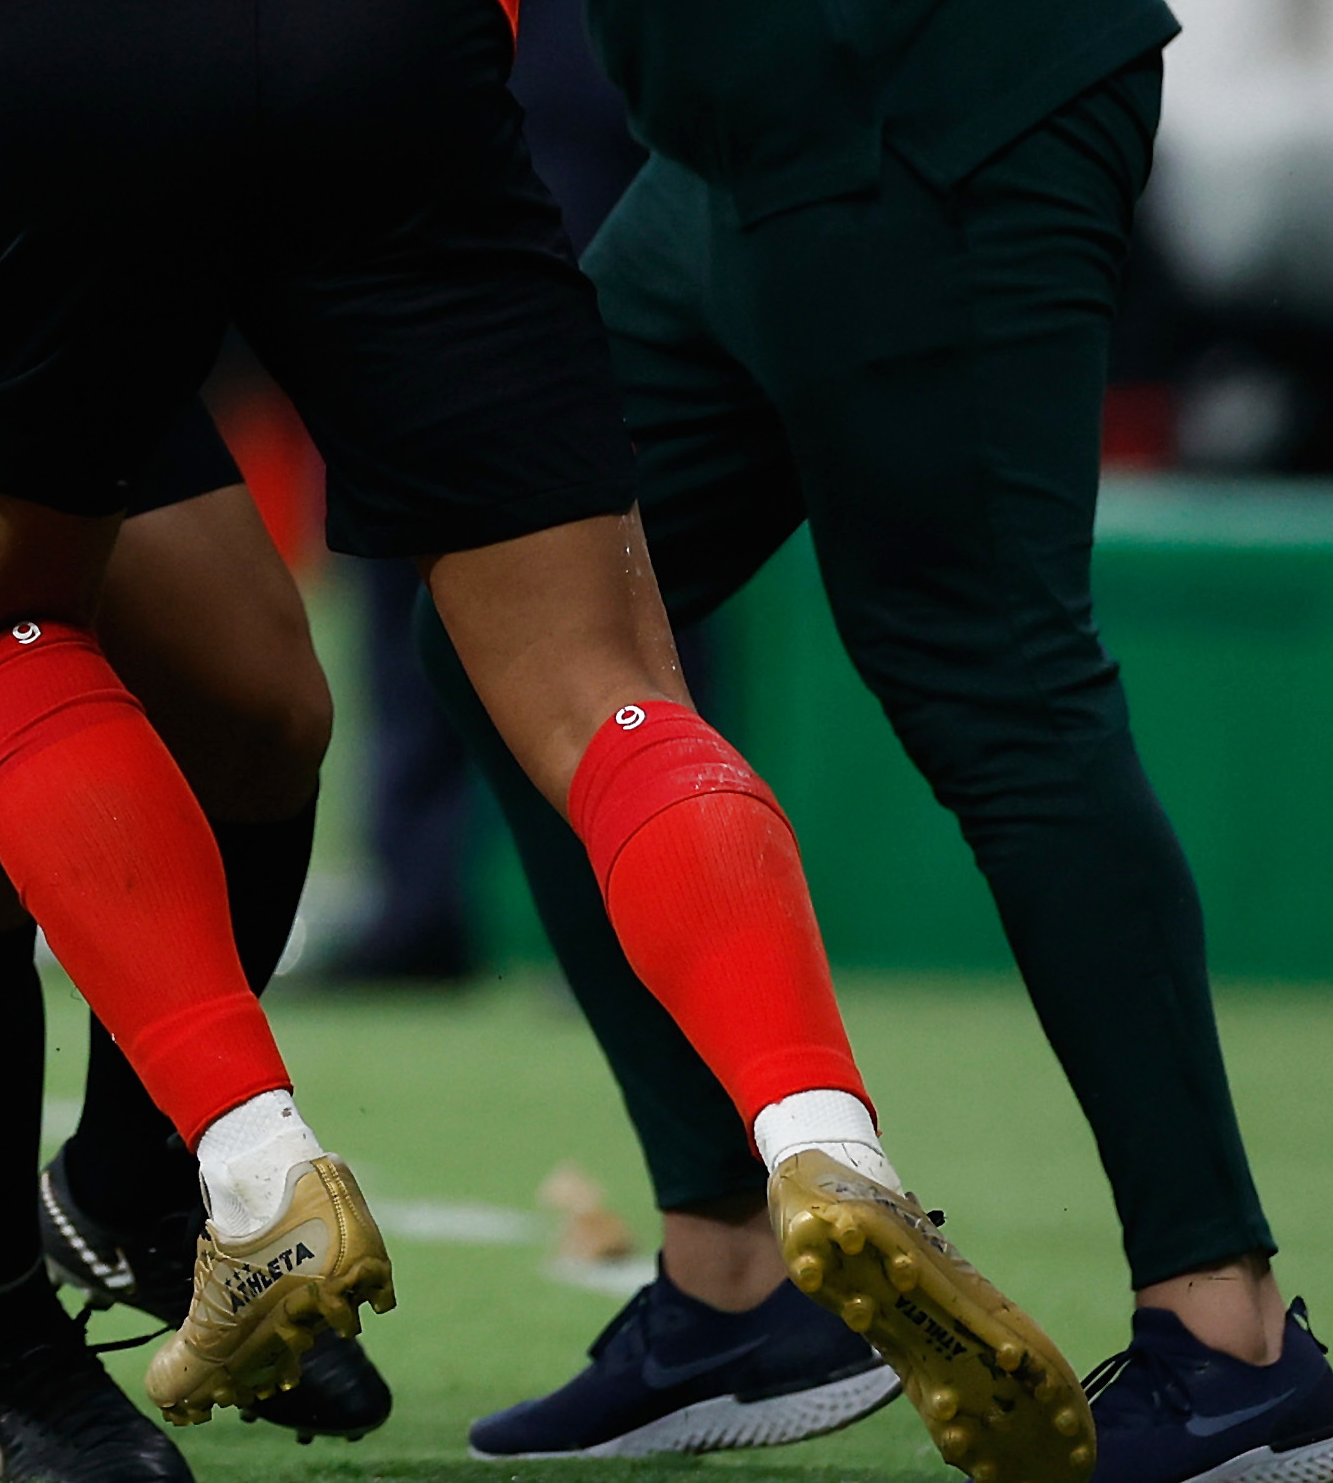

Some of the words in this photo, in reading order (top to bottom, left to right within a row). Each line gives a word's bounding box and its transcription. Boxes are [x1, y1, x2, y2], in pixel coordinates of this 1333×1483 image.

[12, 621, 42, 645] 9
[615, 705, 647, 731] 9
[229, 1241, 315, 1314] ATHLETA
